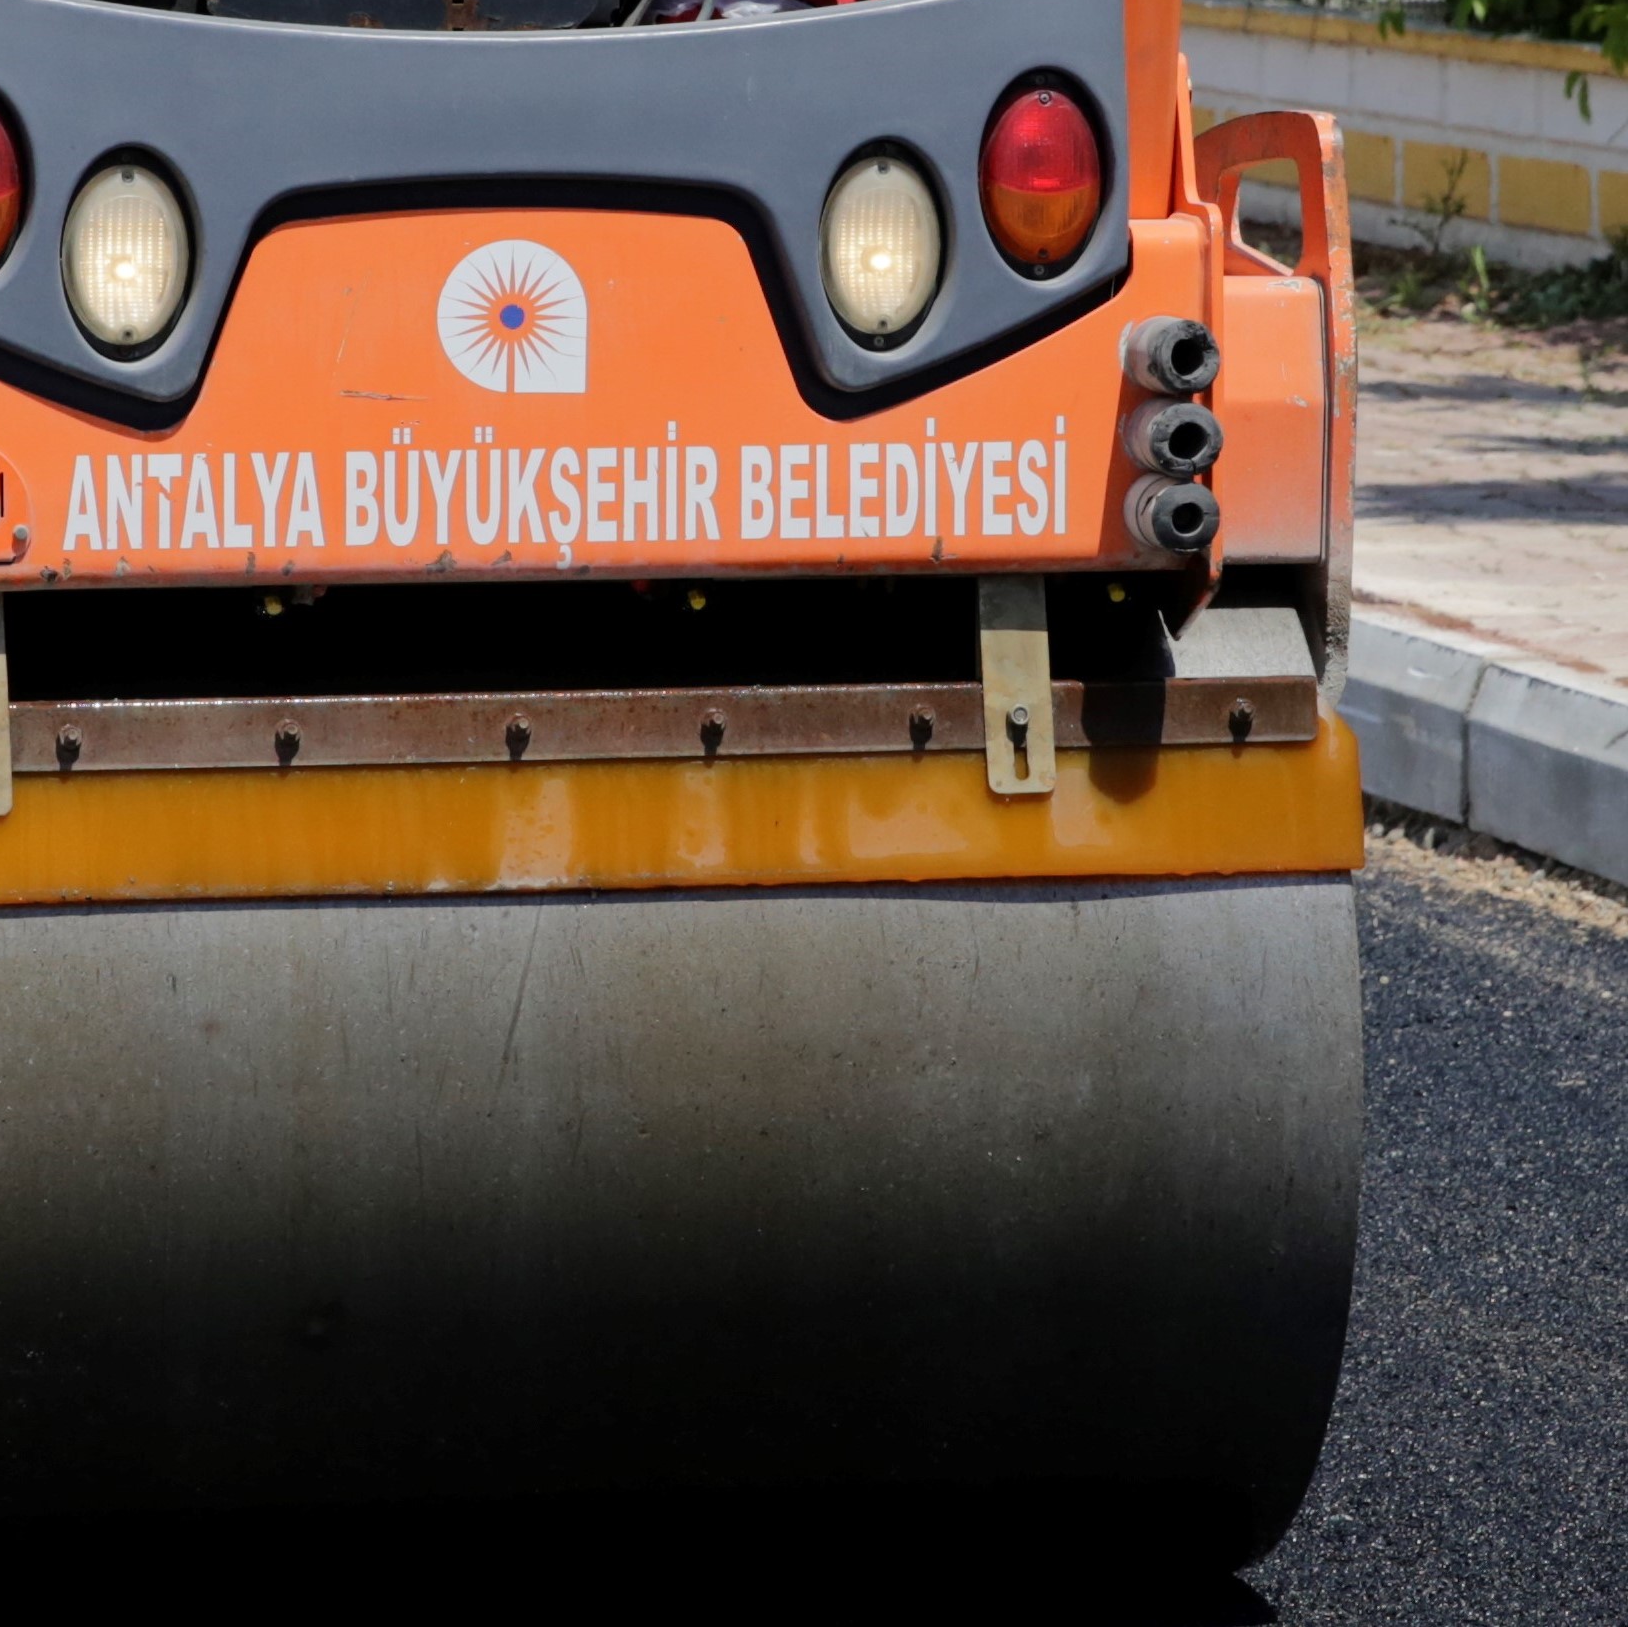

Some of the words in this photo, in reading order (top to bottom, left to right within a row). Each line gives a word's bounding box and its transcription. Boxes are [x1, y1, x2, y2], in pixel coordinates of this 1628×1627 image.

[62, 451, 325, 551] ANTALYA
[345, 420, 721, 569] BÜYÜKŞEHİR
[740, 415, 1067, 540] BELEDİYESİ
